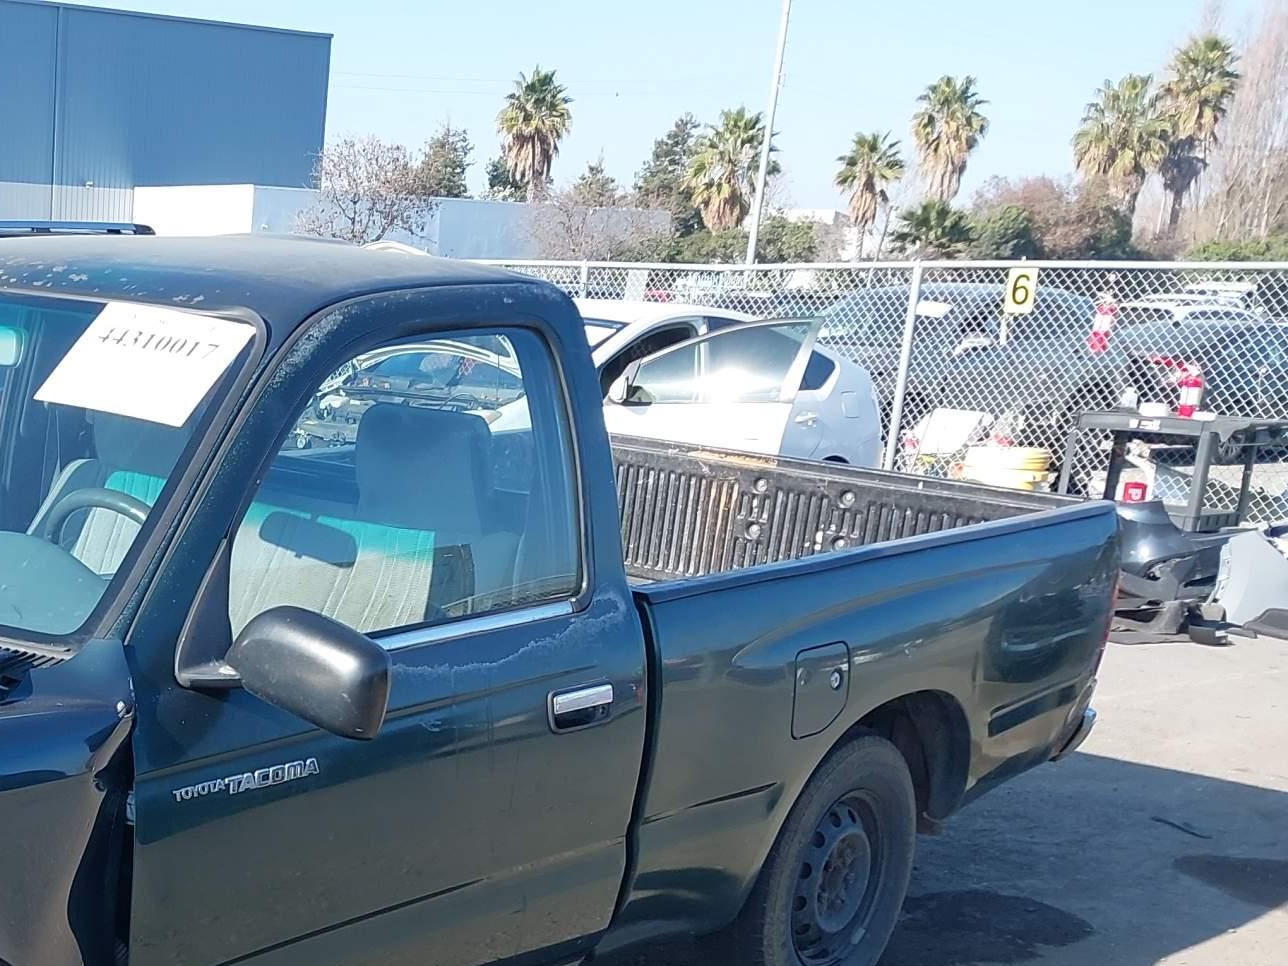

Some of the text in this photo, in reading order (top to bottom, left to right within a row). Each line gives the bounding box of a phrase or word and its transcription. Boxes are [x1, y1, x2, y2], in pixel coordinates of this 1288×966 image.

[1012, 274, 1031, 305] 6
[98, 327, 221, 360] 44310017
[172, 757, 320, 802] TOYOTA TACOMA
